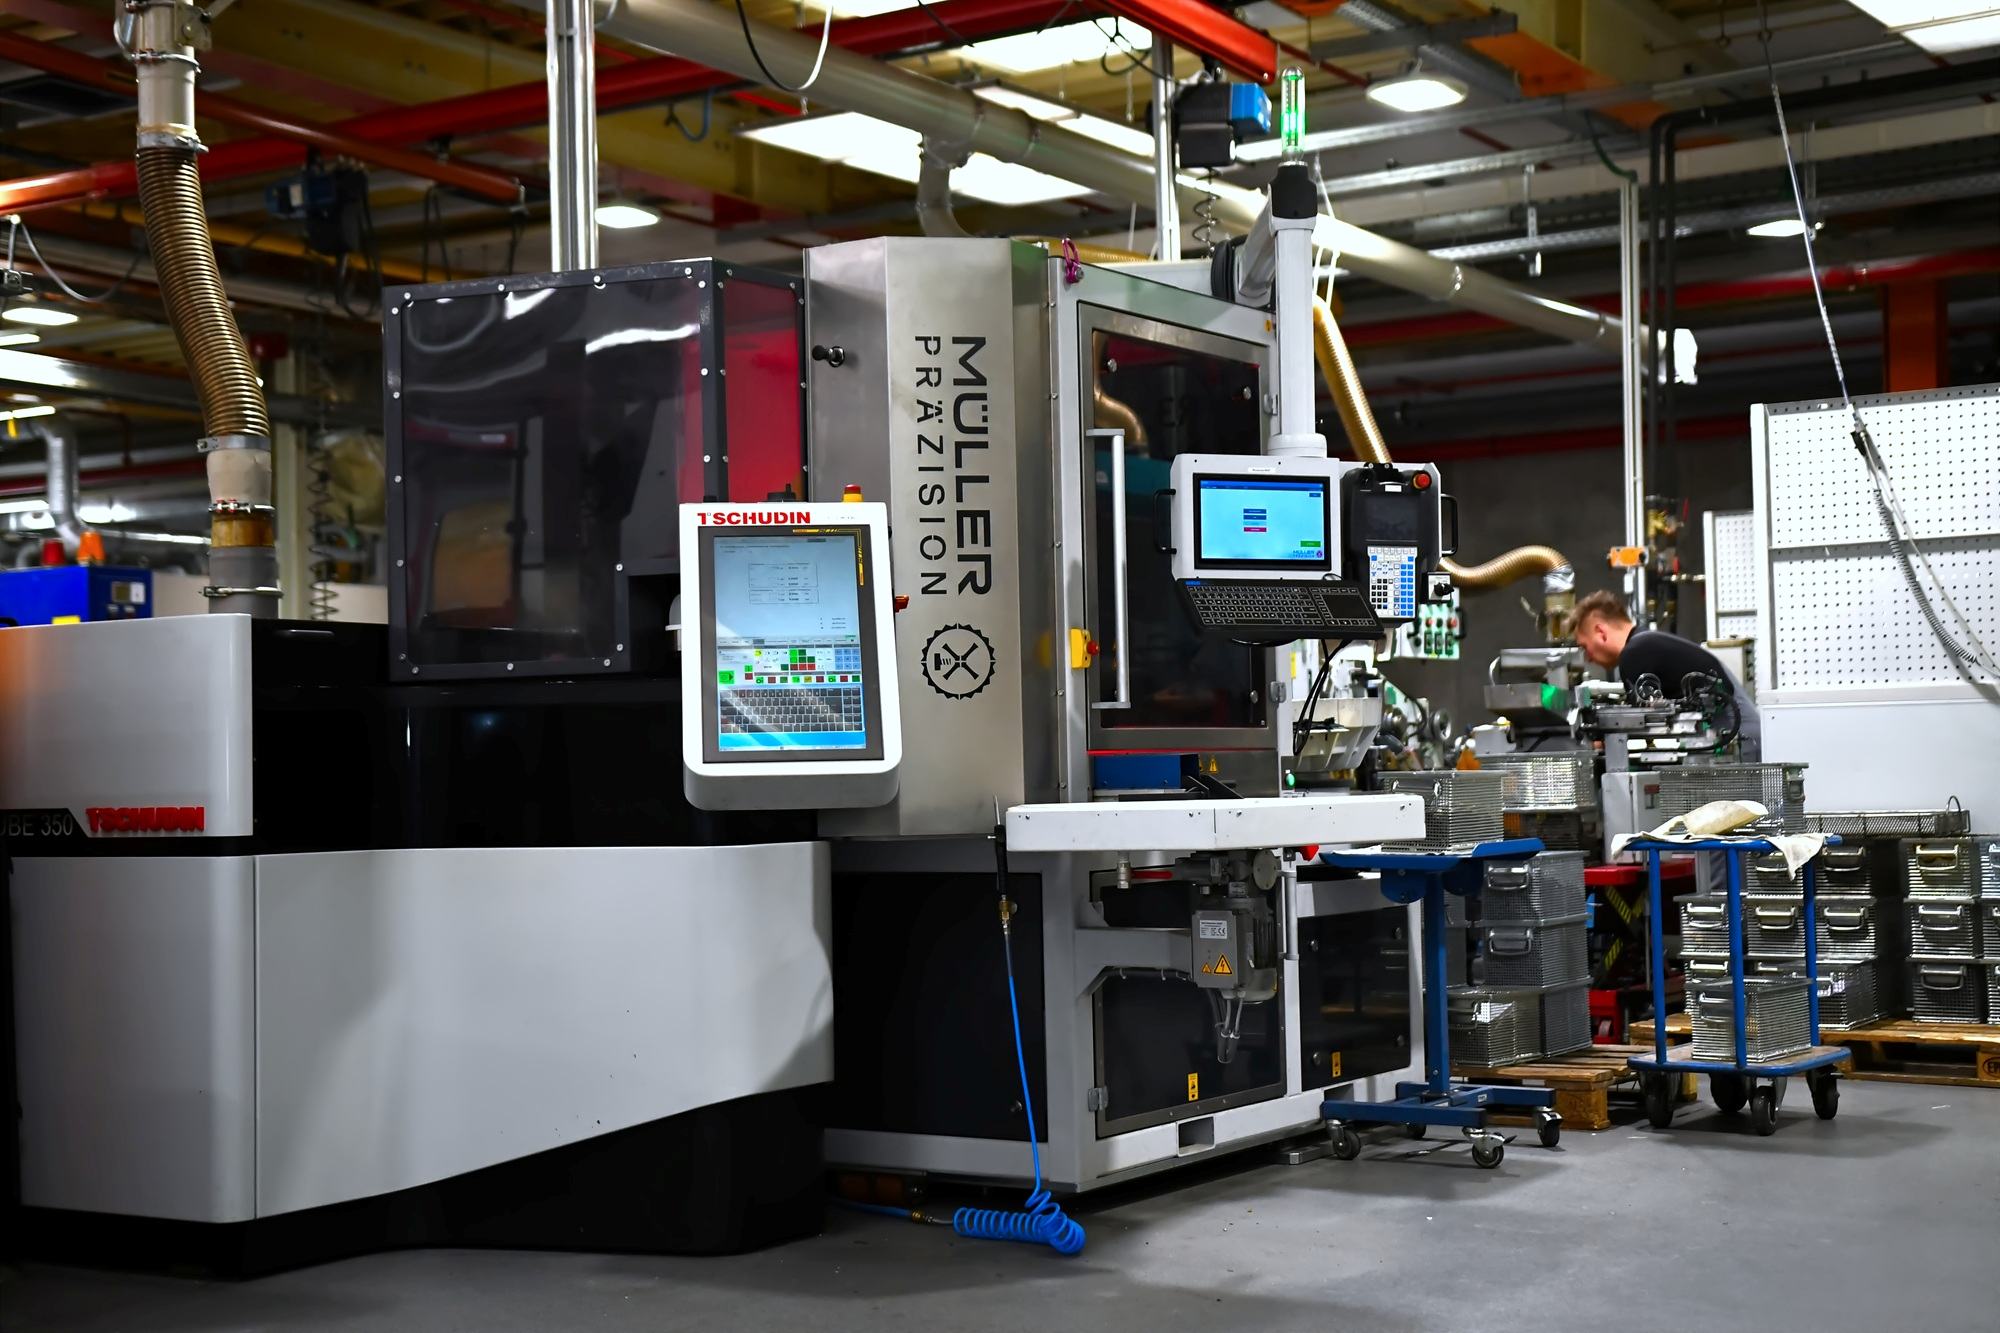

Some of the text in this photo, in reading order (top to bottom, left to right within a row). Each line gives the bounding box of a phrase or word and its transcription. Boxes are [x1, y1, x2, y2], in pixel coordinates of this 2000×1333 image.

[697, 511, 811, 525] TSCHUDIN
[915, 336, 947, 595] PRÄZISION
[952, 336, 993, 596] MÜLLER
[41, 815, 73, 836] 350
